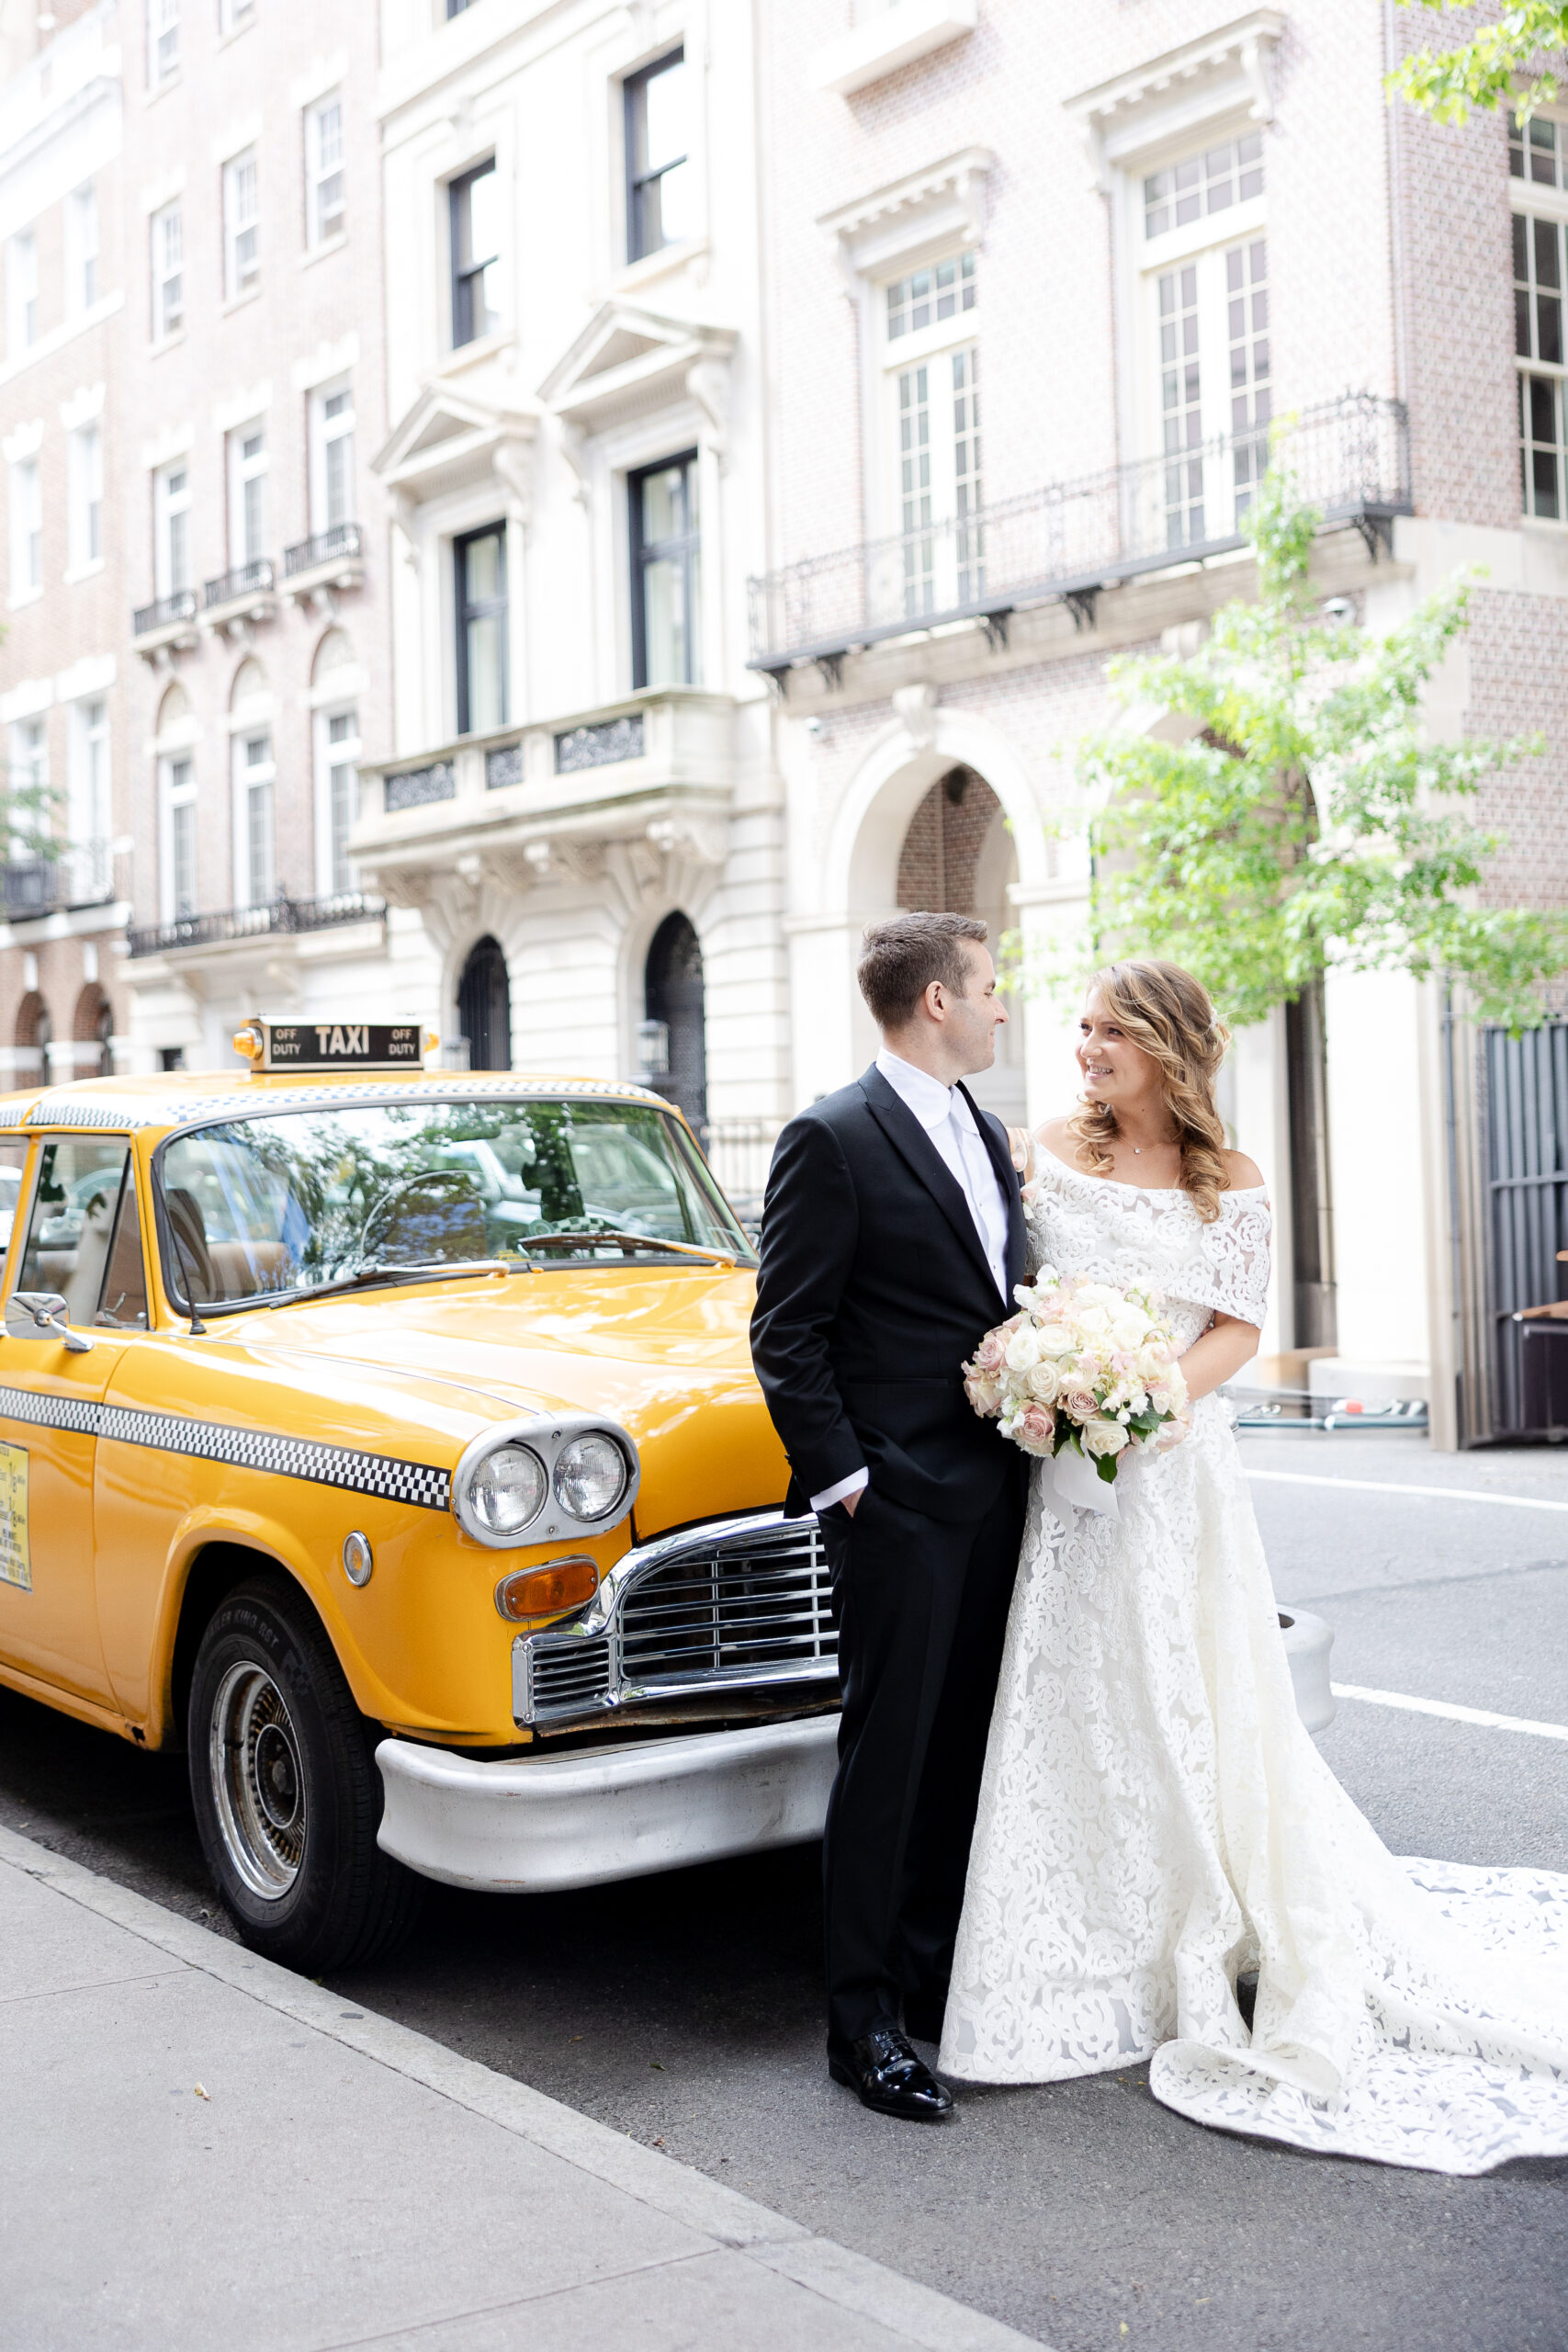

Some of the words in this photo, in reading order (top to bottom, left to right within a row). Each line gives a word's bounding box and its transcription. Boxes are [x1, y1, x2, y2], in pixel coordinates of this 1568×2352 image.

[276, 1028, 298, 1040] OFF
[315, 1025, 369, 1055] TAXI
[391, 1028, 412, 1040] OFF
[273, 1043, 301, 1056] DUTY
[389, 1043, 415, 1056] DUTY
[234, 1609, 258, 1628] KING
[258, 1622, 279, 1648] RST
